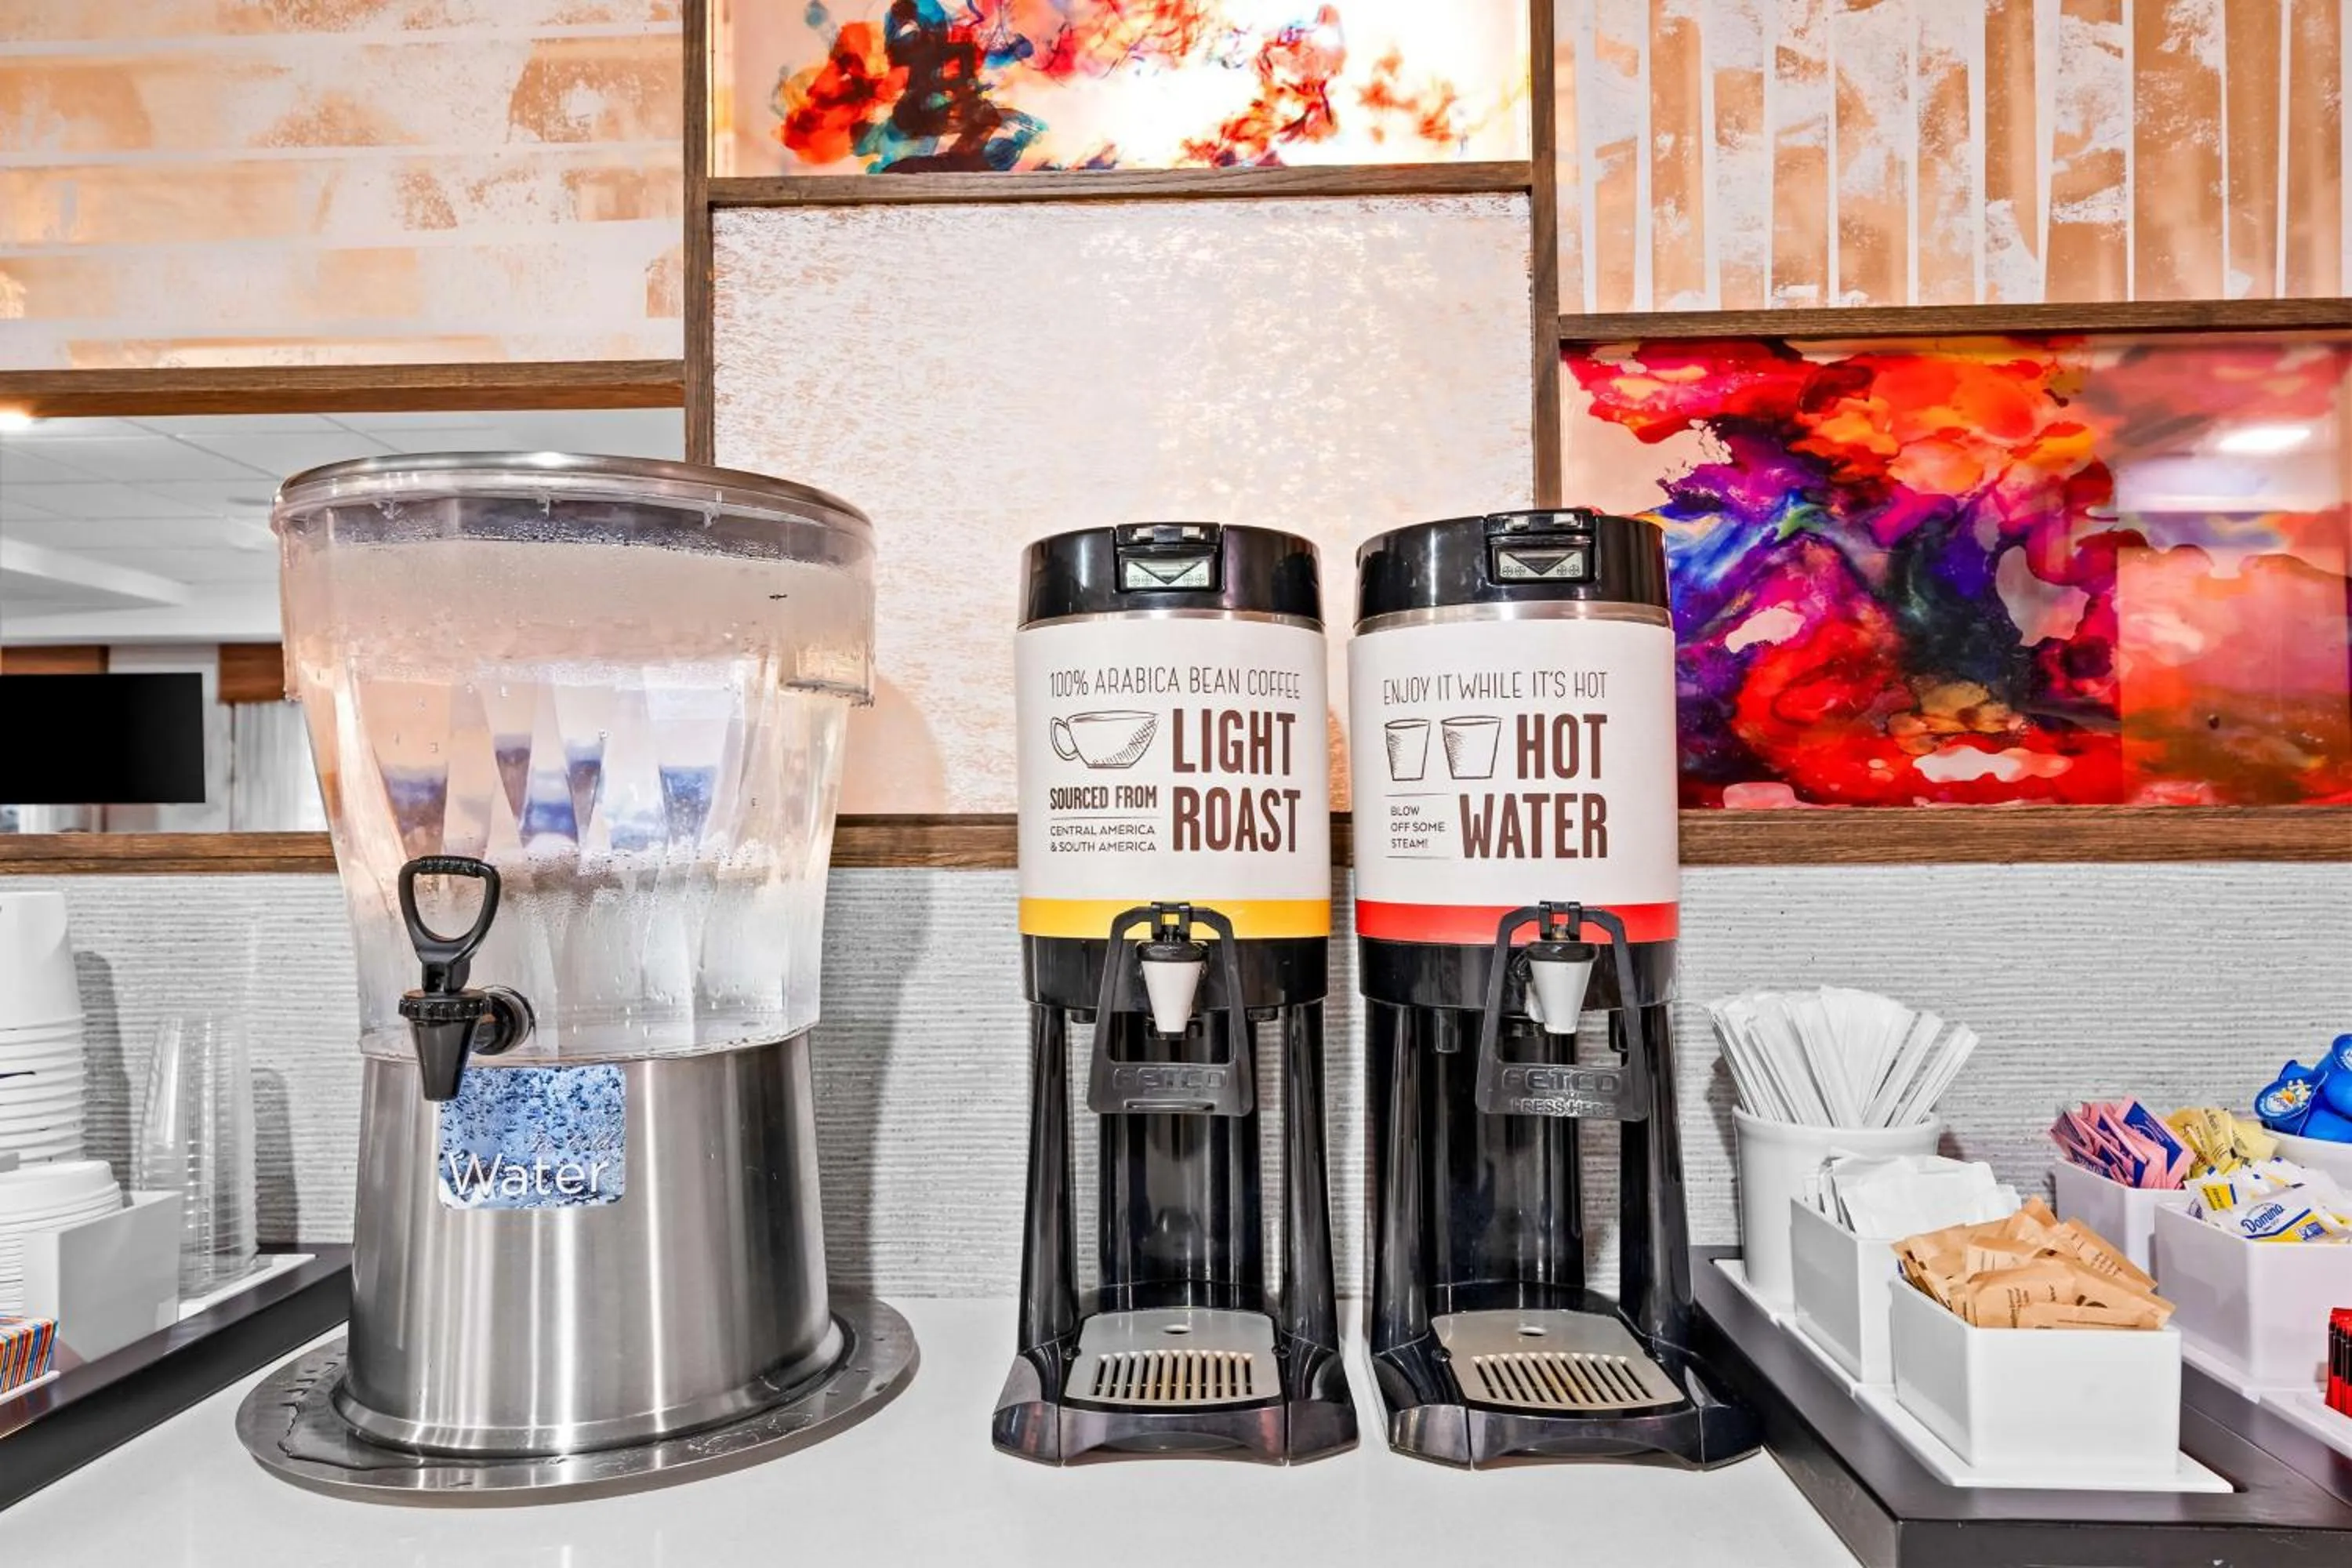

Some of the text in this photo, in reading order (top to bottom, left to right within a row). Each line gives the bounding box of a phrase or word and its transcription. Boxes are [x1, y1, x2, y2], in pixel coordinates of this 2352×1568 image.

[1049, 666, 1301, 699] 100% ARABICA BEAN COFFEE
[1383, 670, 1608, 705] ENJOY IT WHILE IT'S HOT
[1172, 708, 1296, 776] LIGHT
[1516, 713, 1608, 780] HOT
[1049, 785, 1158, 811] SOURCED FROM
[1390, 805, 1420, 816] BLOW
[1050, 824, 1156, 837] CENTRAL AMERICA
[1172, 786, 1301, 853] ROAST
[1390, 822, 1446, 832] OFF SOME
[1459, 793, 1608, 859] WATER
[1098, 840, 1156, 852] AMERICA
[1501, 1067, 1621, 1094] FETCO
[448, 1152, 609, 1196] Water
[2240, 1203, 2285, 1233] Domino
